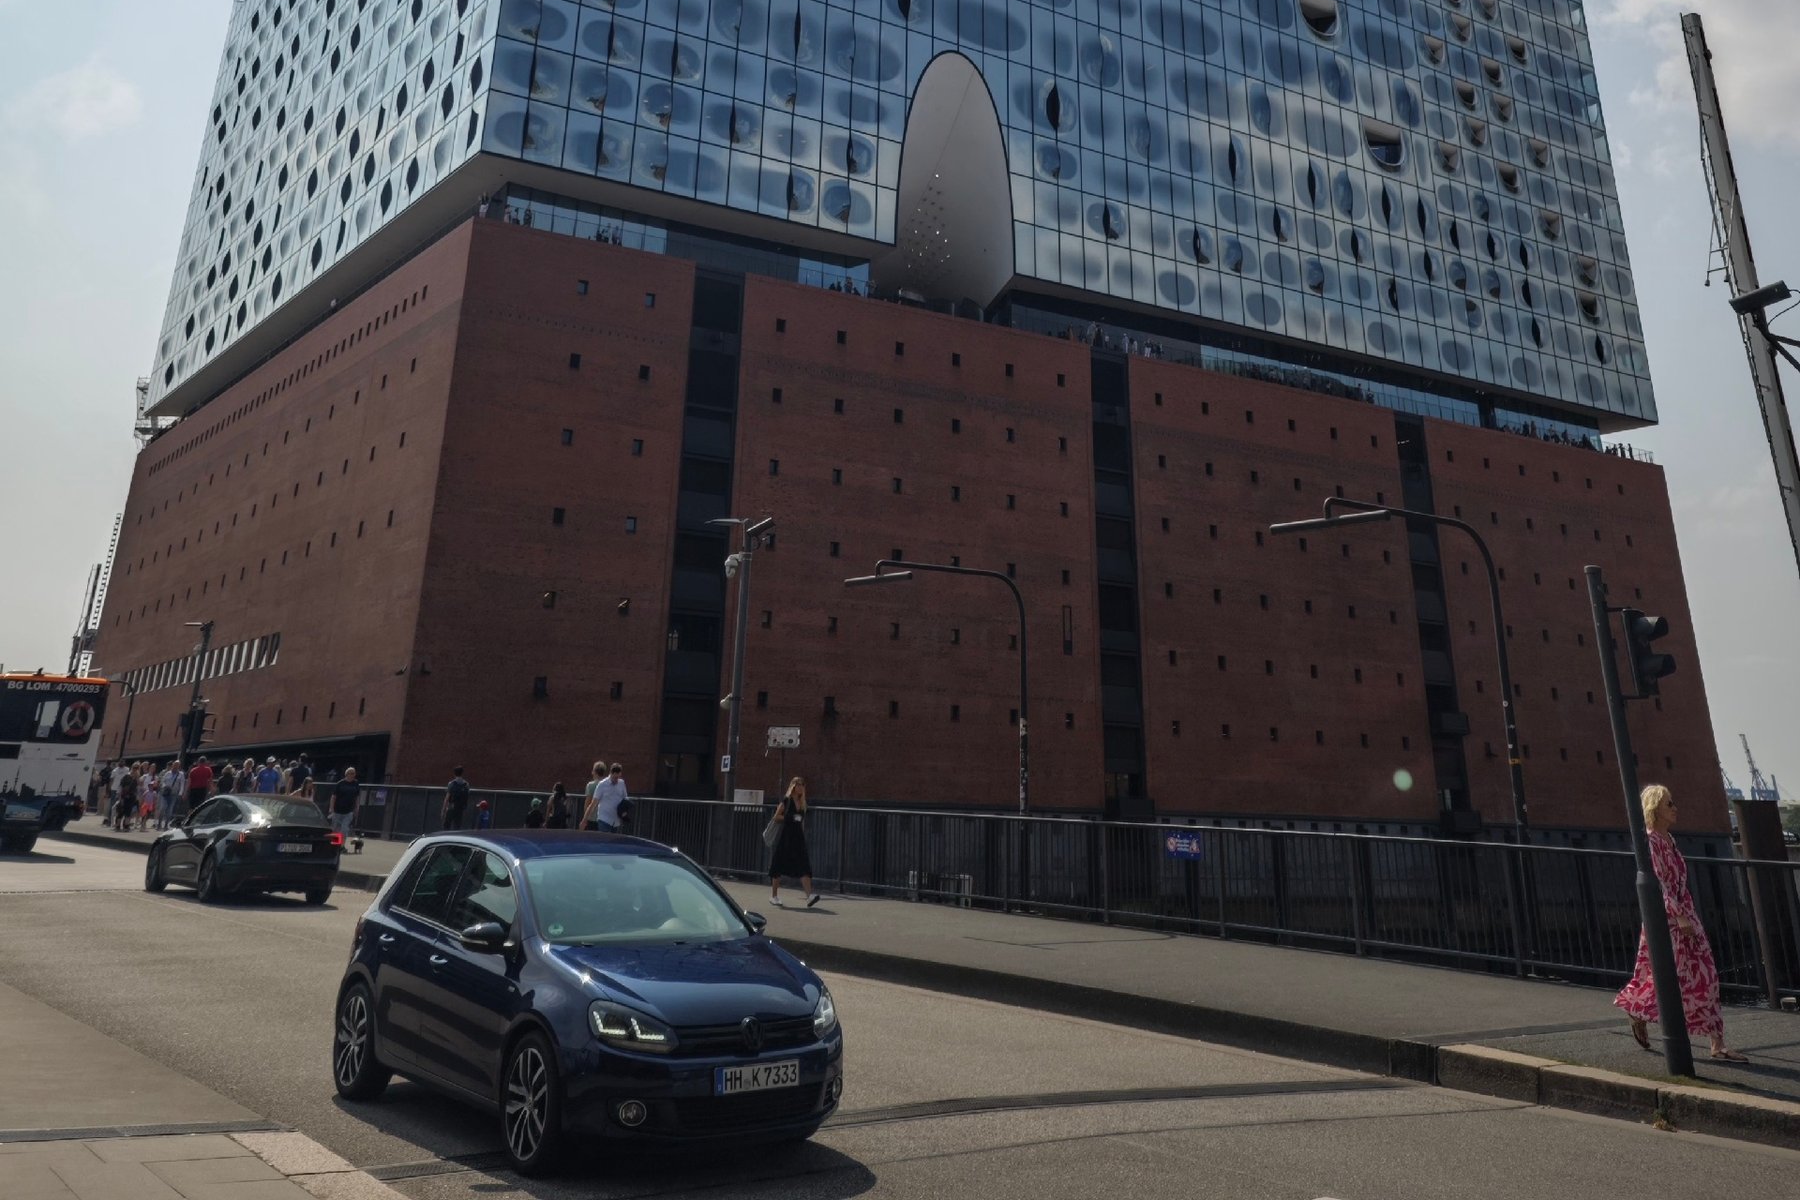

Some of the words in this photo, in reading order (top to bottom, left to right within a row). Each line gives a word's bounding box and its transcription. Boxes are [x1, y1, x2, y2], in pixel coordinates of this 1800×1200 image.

[7, 681, 24, 689] BG
[26, 682, 51, 691] LOM
[55, 683, 100, 693] 47000293
[724, 1069, 742, 1091] HH
[752, 1068, 760, 1087] K
[764, 1064, 797, 1086] 7333
